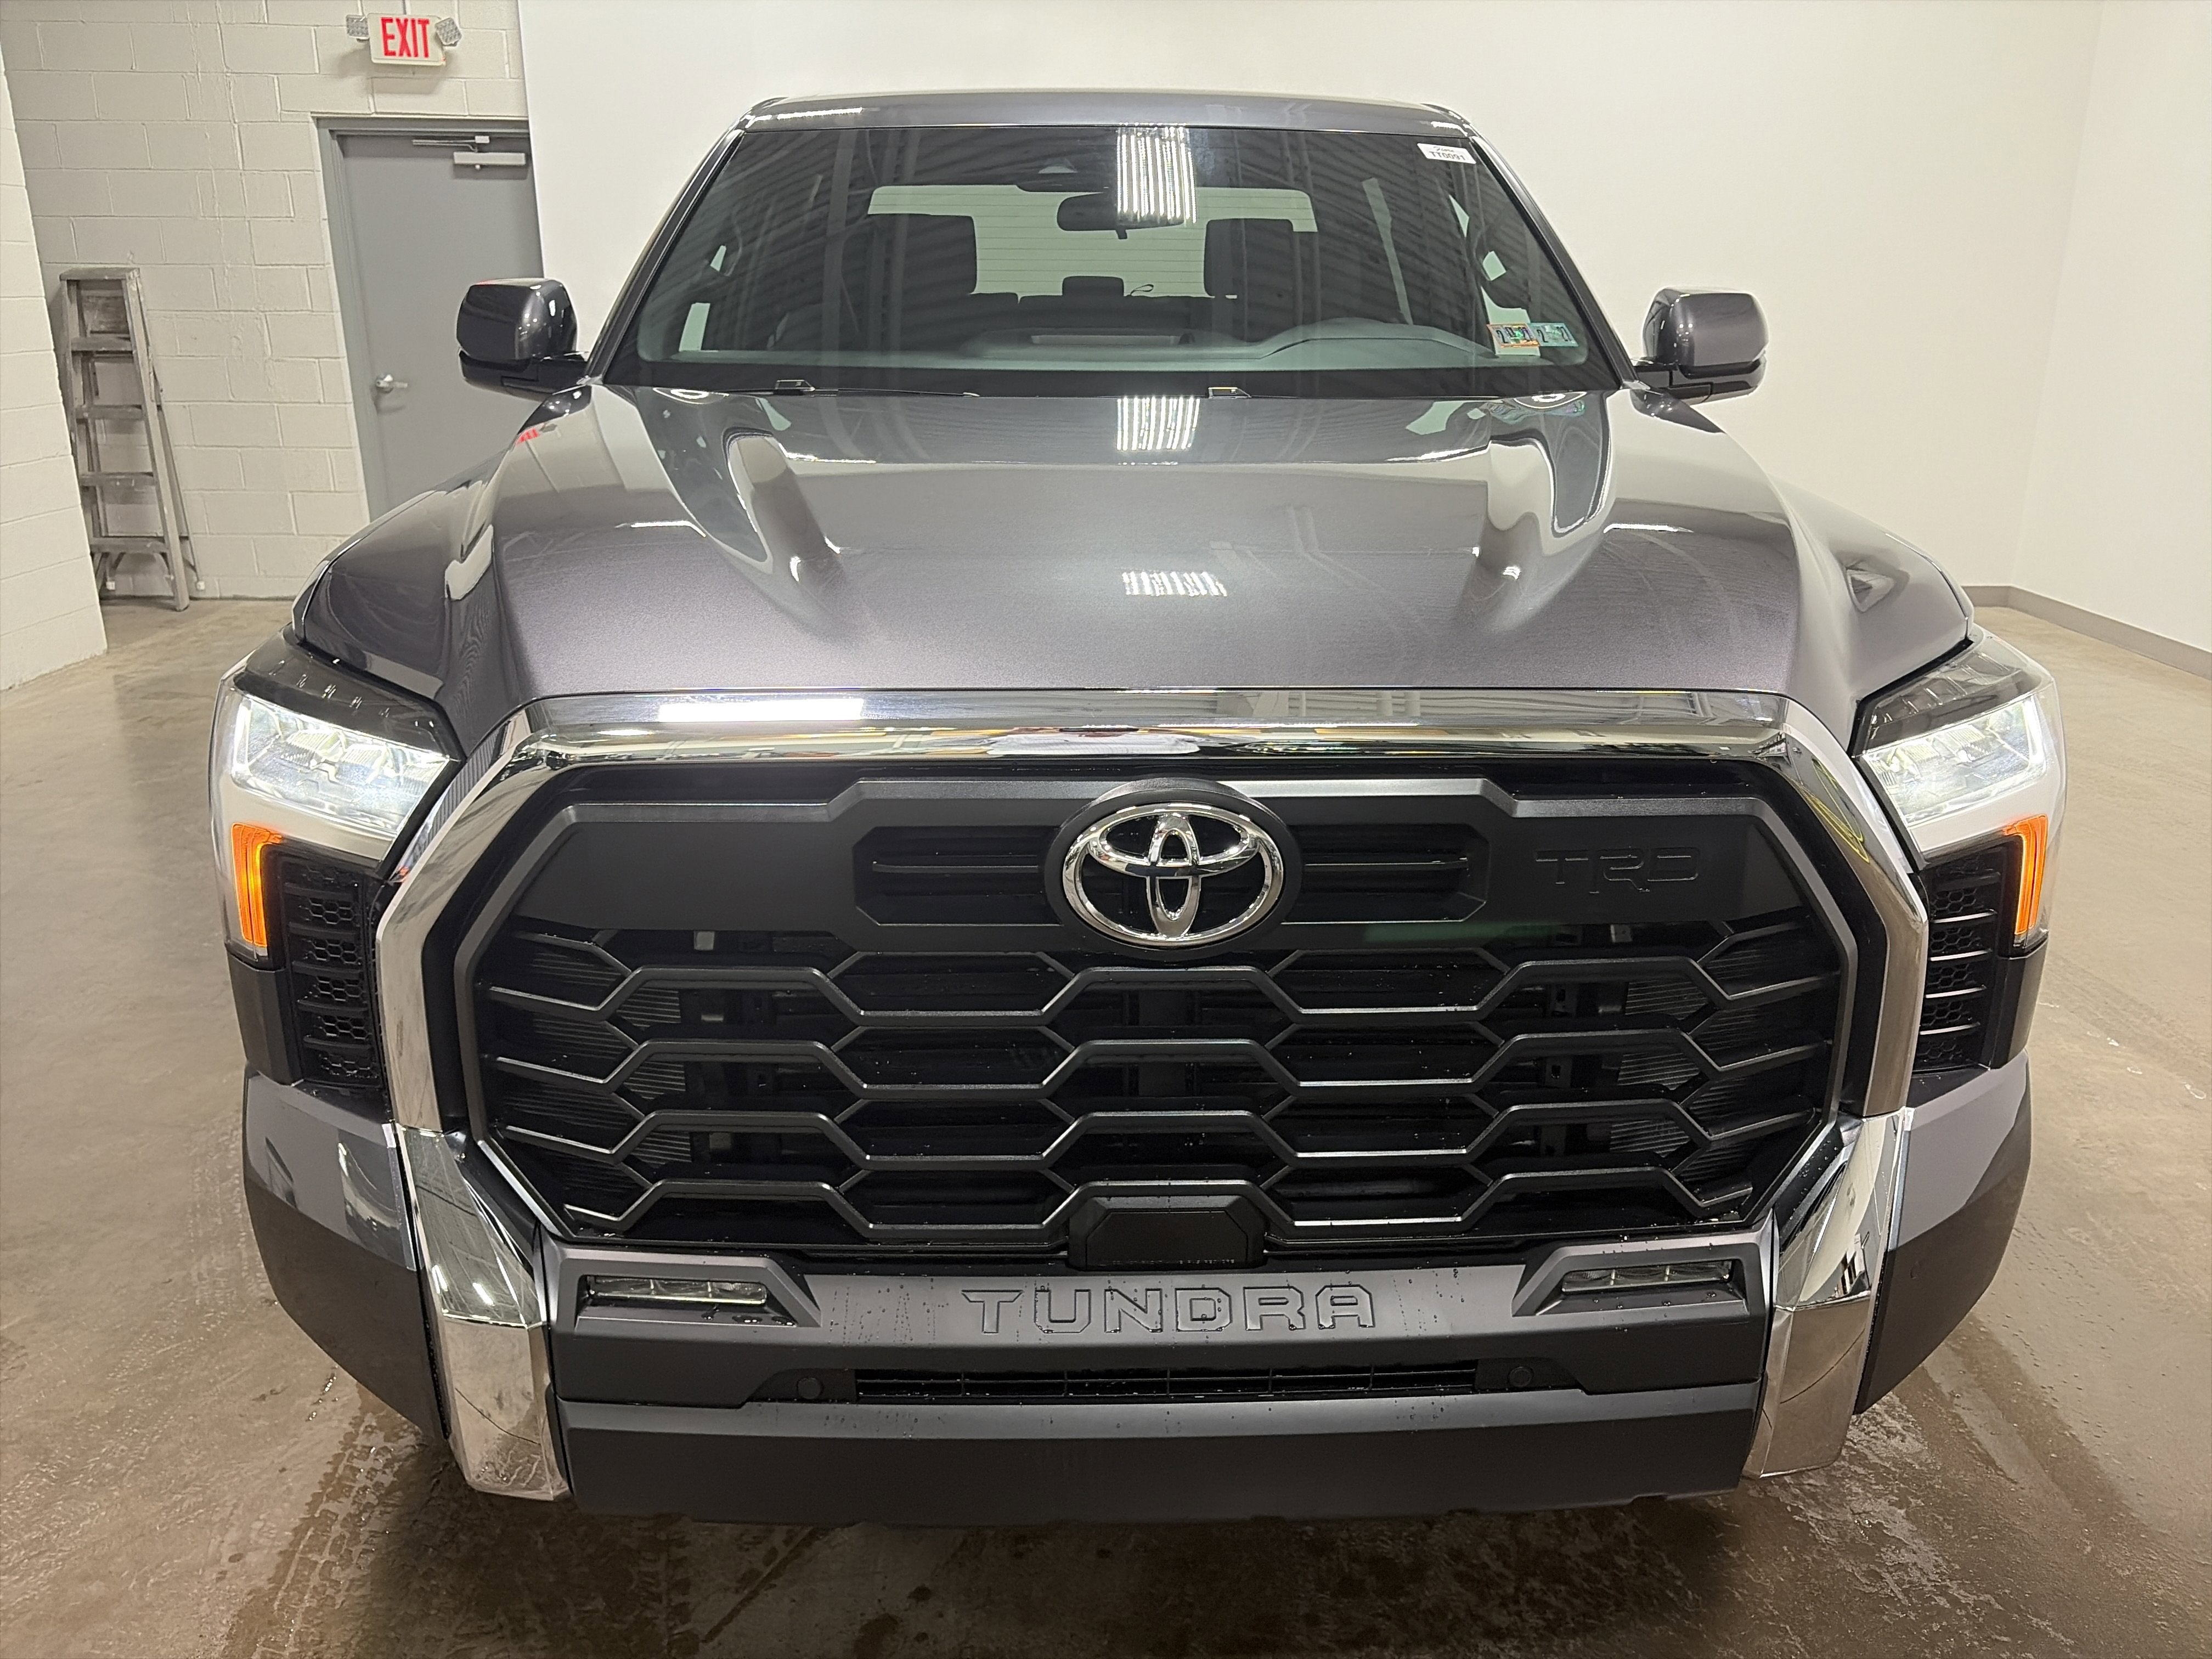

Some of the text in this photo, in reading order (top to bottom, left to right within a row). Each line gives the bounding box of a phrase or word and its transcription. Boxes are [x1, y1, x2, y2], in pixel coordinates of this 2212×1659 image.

[380, 16, 430, 59] EXIT
[1429, 151, 1466, 161] TT0091
[1536, 847, 1700, 894] TRD
[961, 1284, 1375, 1334] TUNDRA
